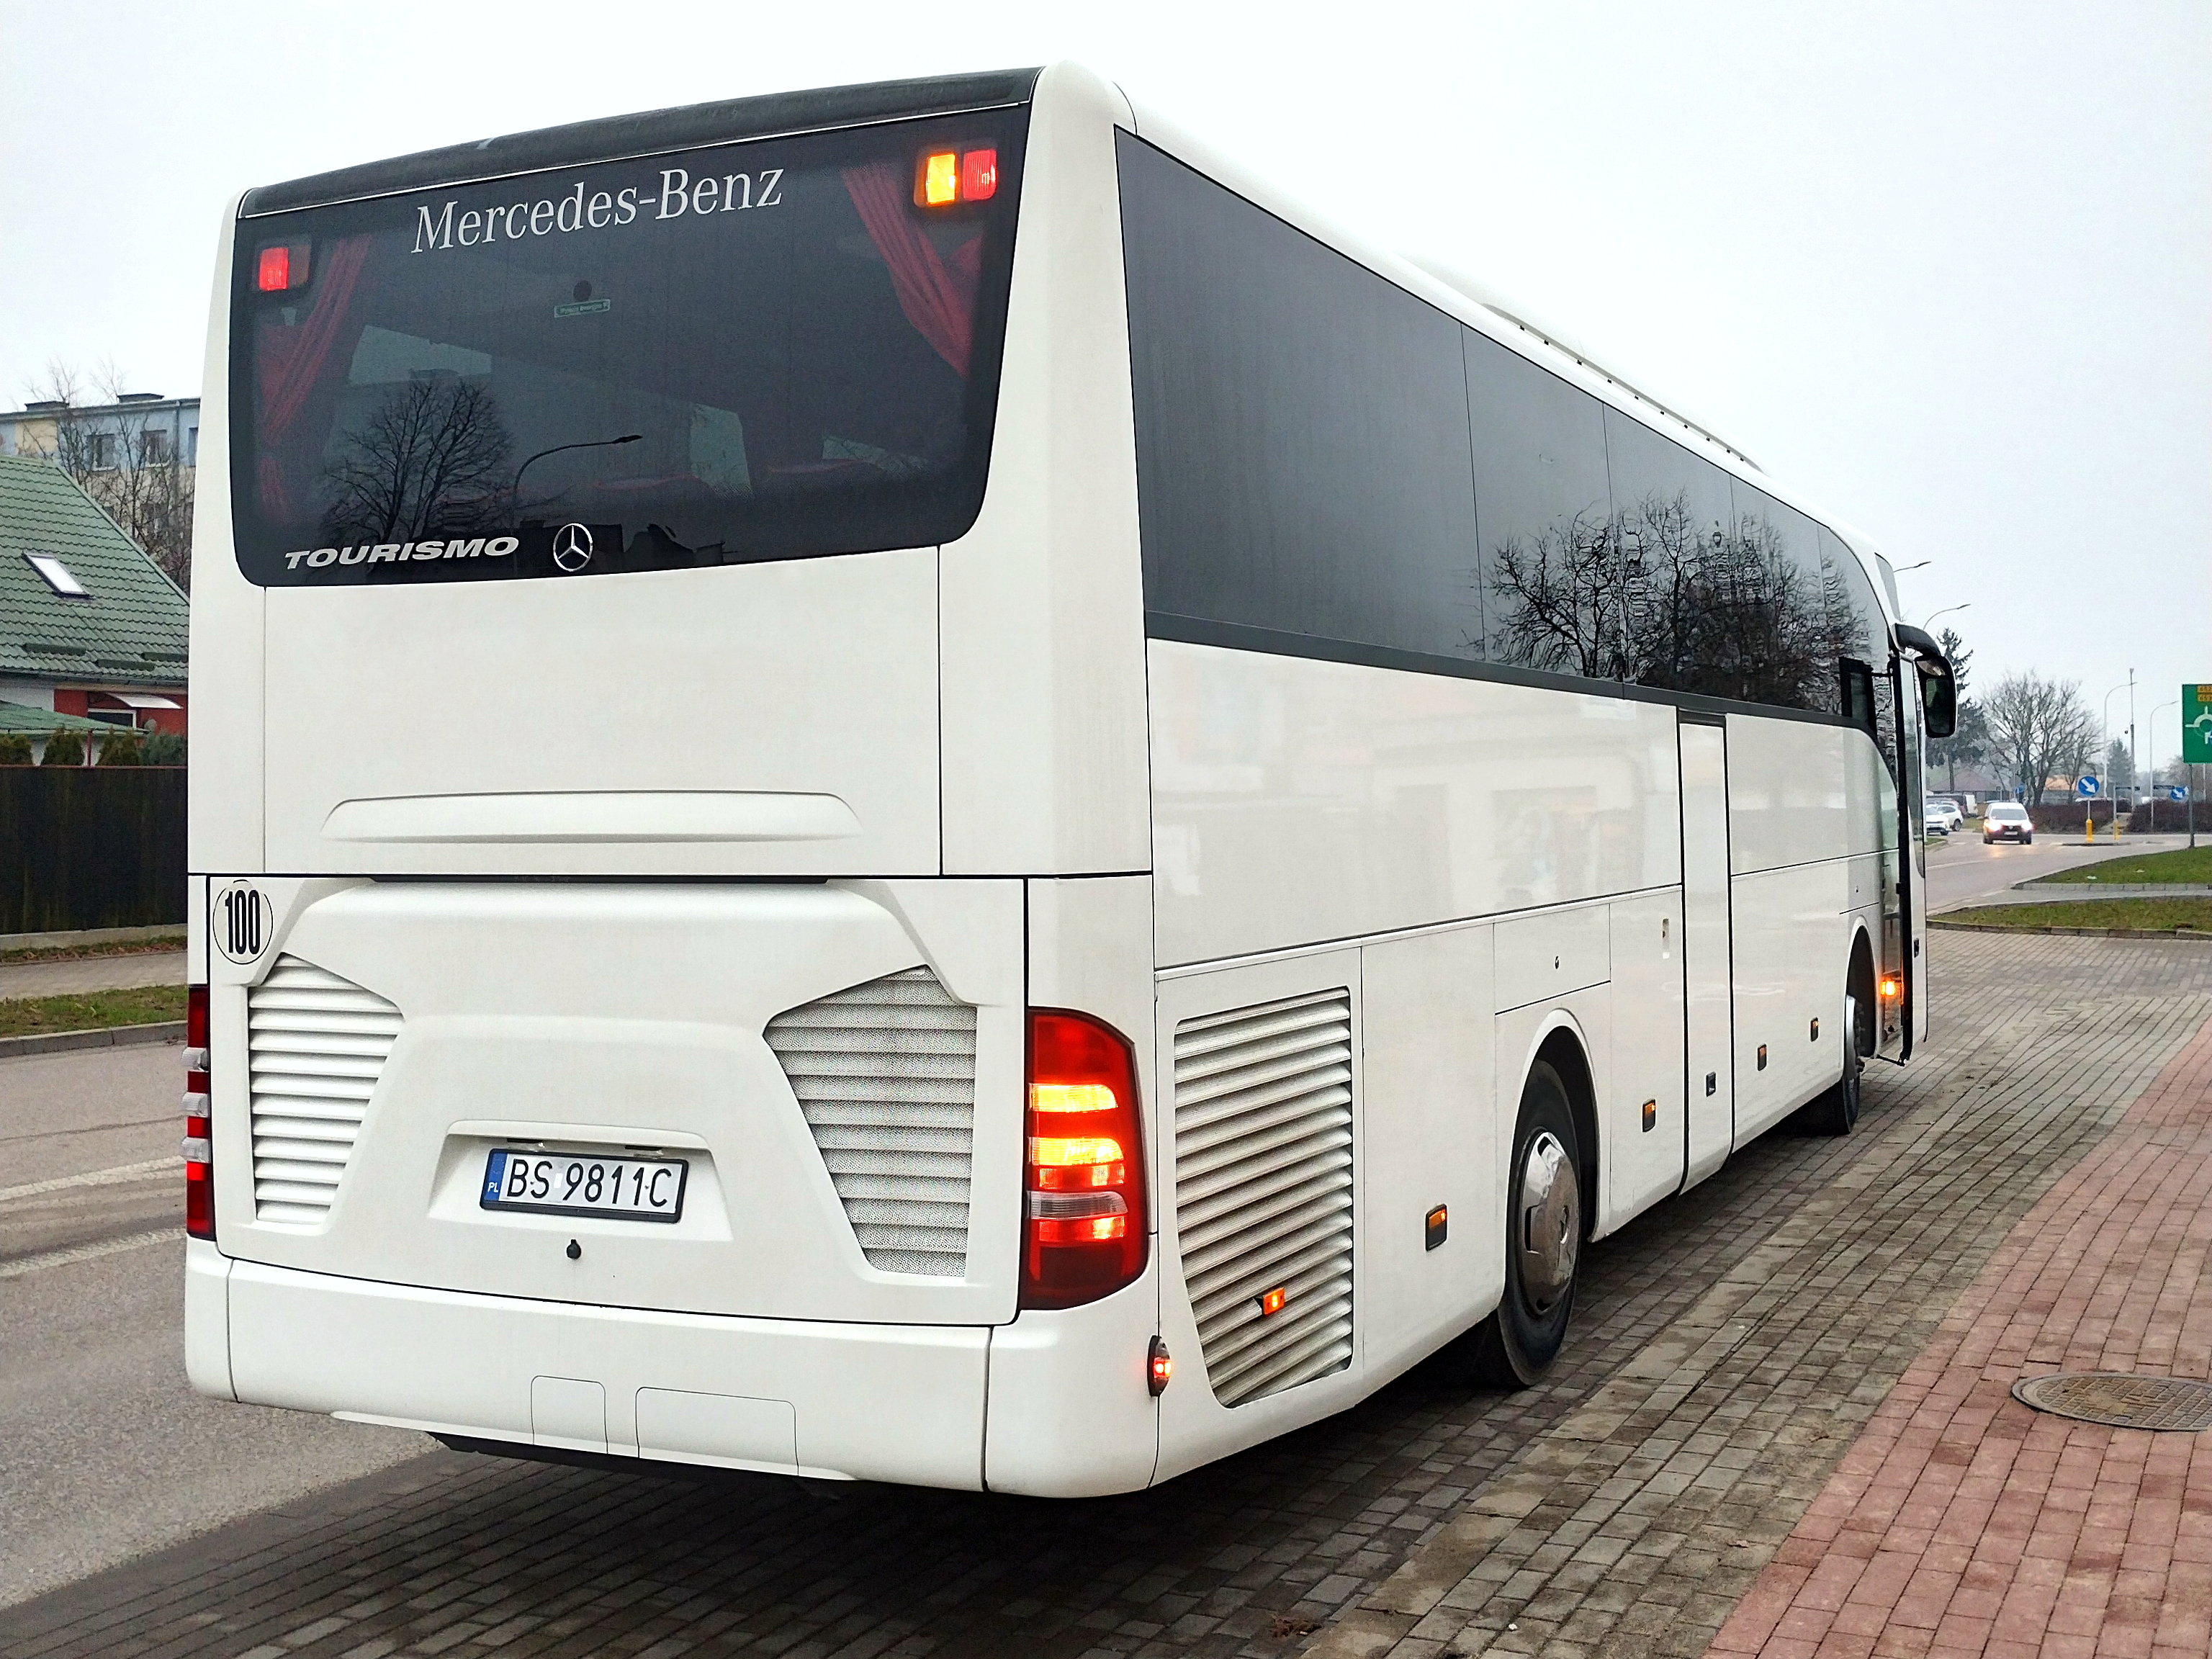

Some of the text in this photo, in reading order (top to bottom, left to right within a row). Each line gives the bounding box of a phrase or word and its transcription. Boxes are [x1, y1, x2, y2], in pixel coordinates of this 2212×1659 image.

[410, 168, 785, 254] Mercedes-Benz
[284, 536, 519, 570] TOURISMO
[225, 889, 261, 955] 100
[487, 1182, 499, 1193] PL
[507, 1158, 672, 1208] BS 9811C
